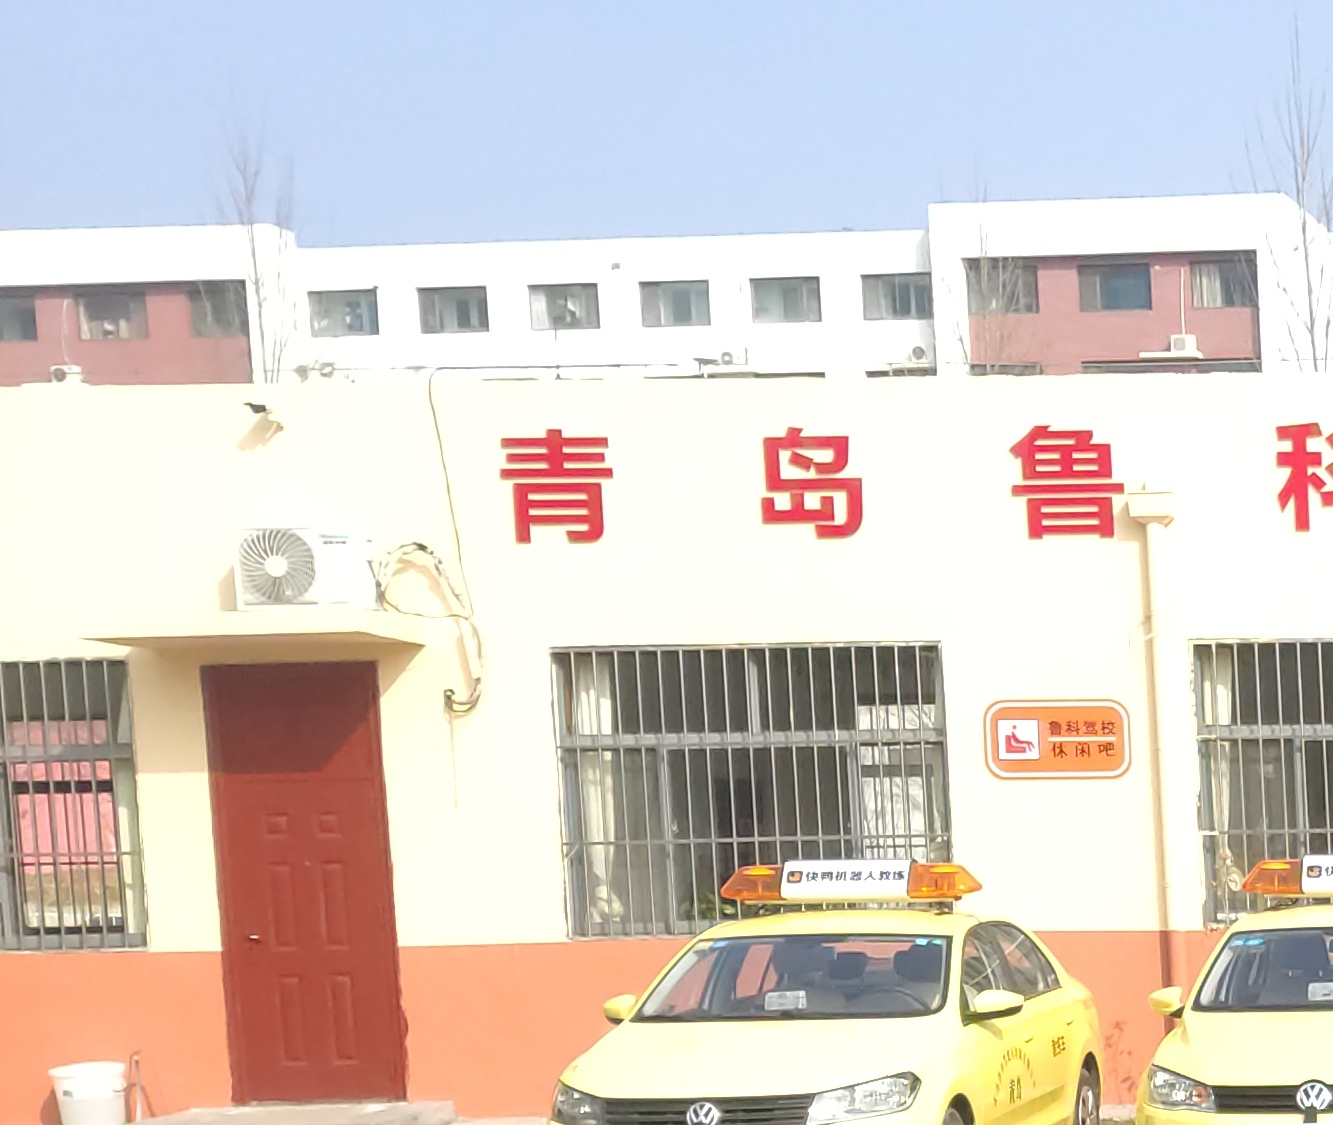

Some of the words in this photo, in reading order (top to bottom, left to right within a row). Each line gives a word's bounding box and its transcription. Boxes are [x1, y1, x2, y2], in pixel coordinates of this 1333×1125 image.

[1048, 720, 1117, 736] 鲁科驾校
[1052, 742, 1116, 759] 休闲吧
